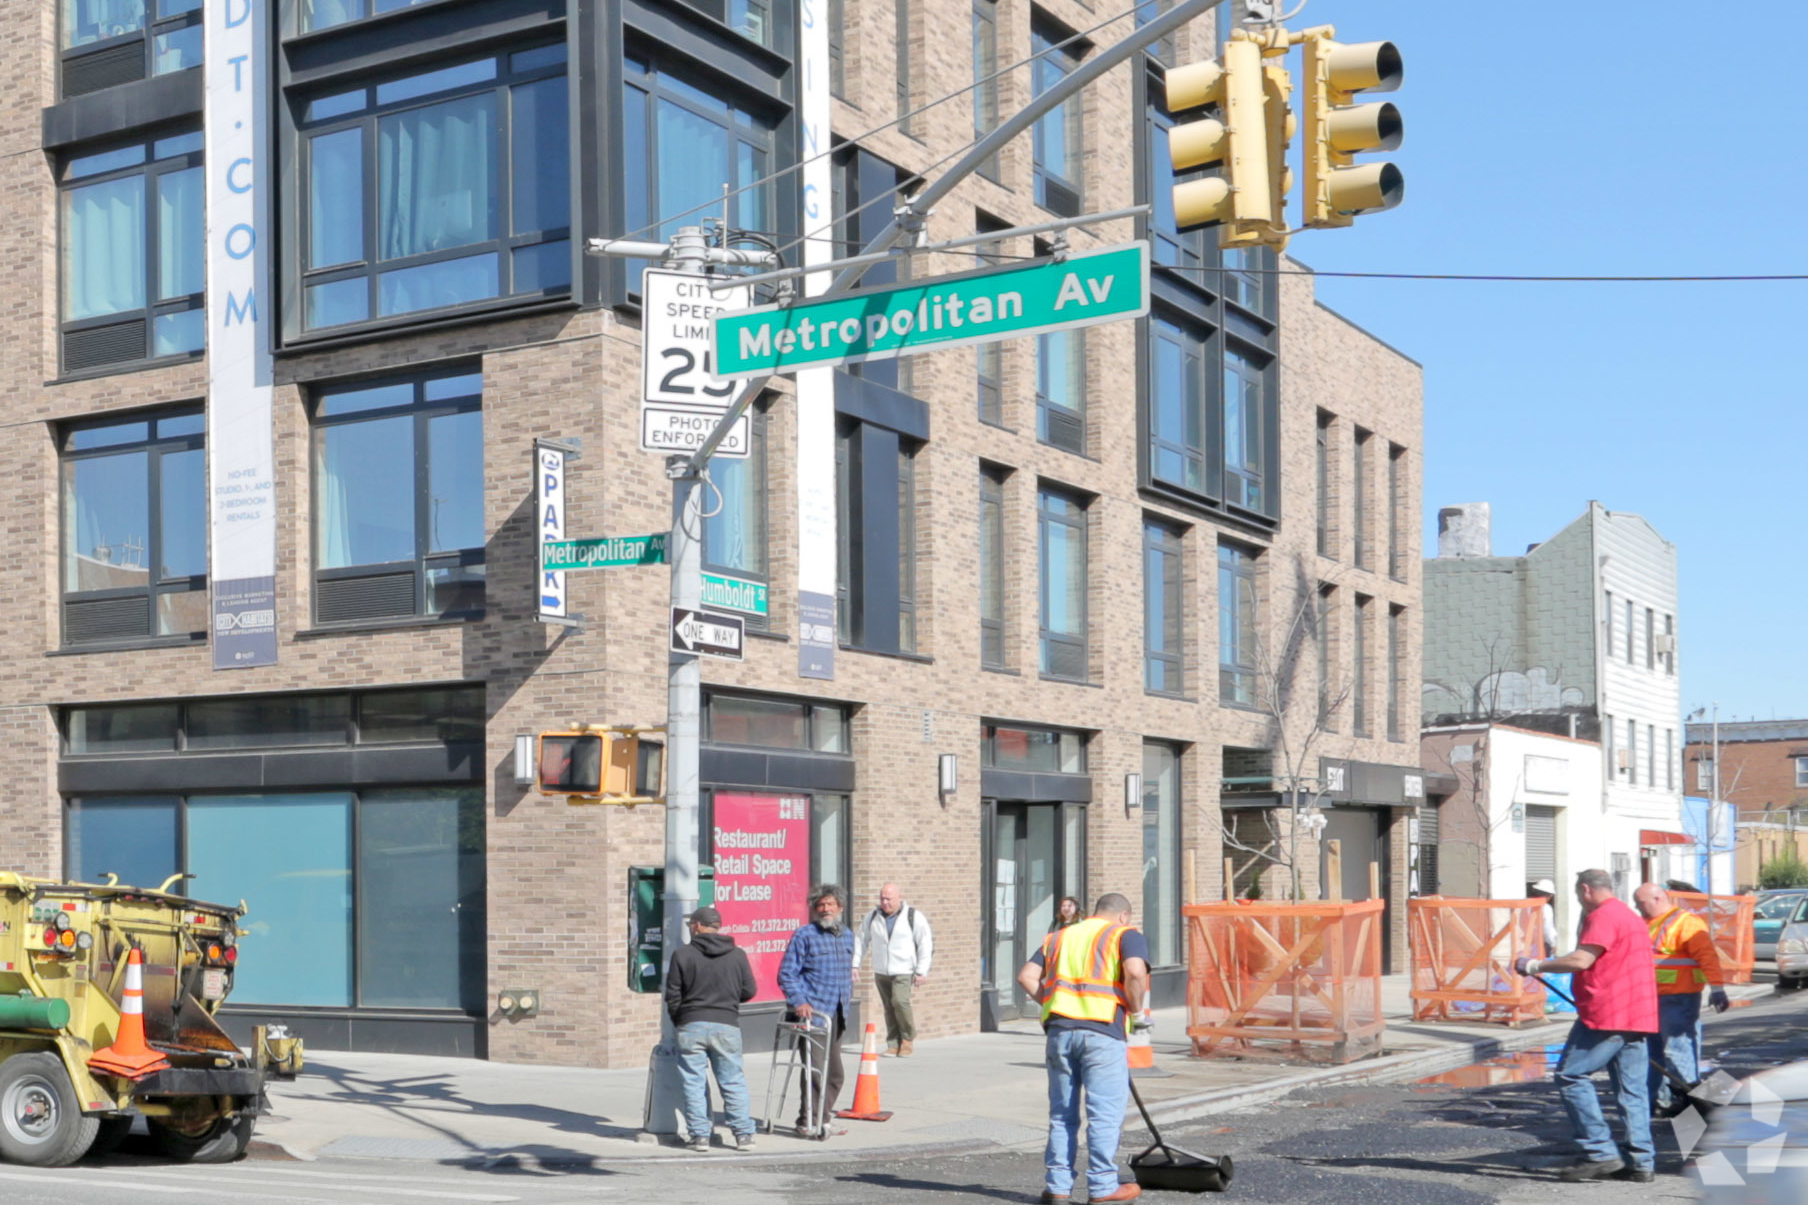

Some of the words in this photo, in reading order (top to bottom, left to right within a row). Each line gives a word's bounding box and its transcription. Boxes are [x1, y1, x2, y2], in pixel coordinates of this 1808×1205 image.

[676, 282, 718, 300] CITY
[739, 291, 1024, 360] Metropolitan
[1054, 271, 1115, 311] Av
[673, 324, 710, 340] LIMI
[652, 430, 740, 448] ENFORD
[255, 481, 272, 491] AND
[227, 511, 260, 522] RENTALS
[543, 473, 561, 590] PAK
[544, 539, 645, 567] Metropolitan
[651, 538, 666, 551] Av
[701, 577, 756, 611] Humboldt
[683, 622, 704, 640] ONE
[713, 627, 735, 644] WAY
[714, 826, 787, 849] Restaurant/
[714, 854, 749, 874] Retail
[752, 854, 791, 879] Space
[714, 881, 731, 901] for
[733, 881, 772, 902] Lease
